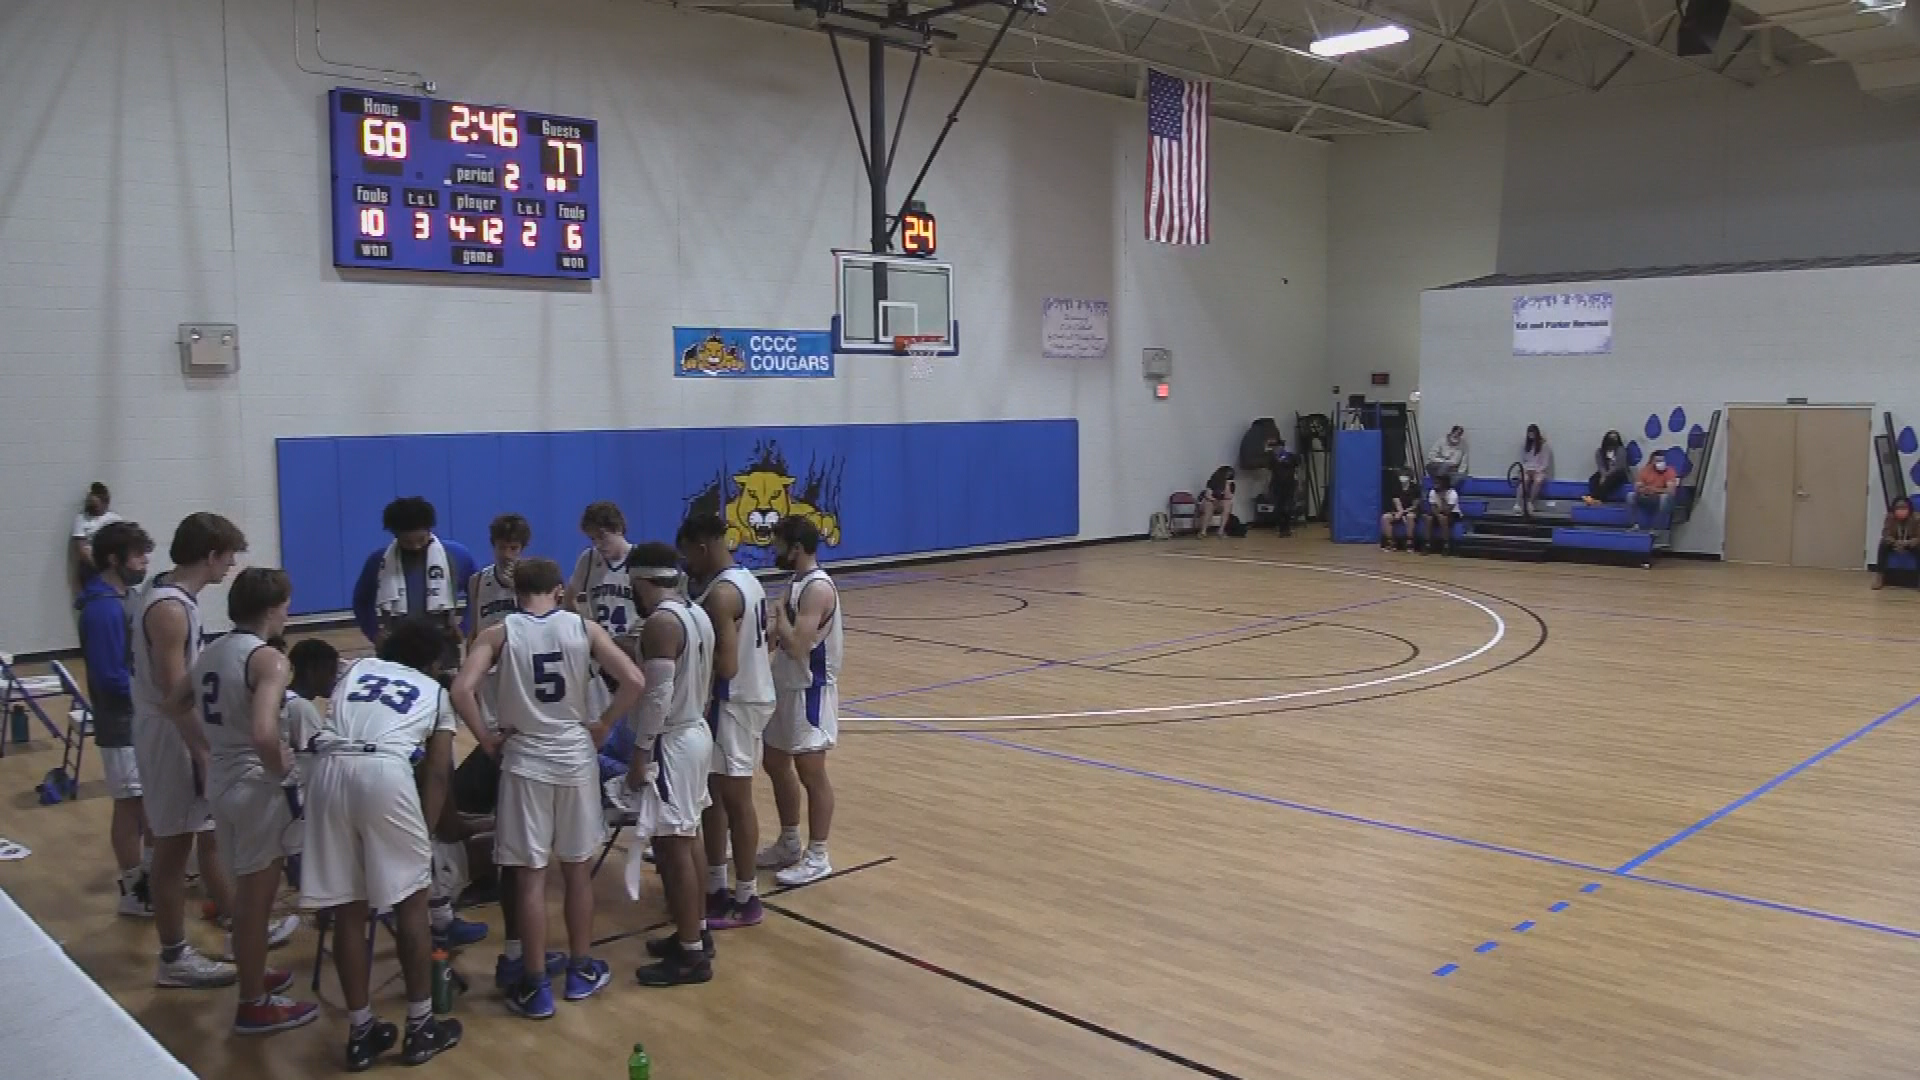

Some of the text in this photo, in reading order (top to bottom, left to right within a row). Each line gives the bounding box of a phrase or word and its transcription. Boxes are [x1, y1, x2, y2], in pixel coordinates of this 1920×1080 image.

[364, 98, 398, 116] Home
[362, 118, 407, 159] 68
[450, 105, 519, 148] 2:46
[542, 120, 581, 139] Guests
[547, 140, 582, 177] 77
[456, 167, 494, 186] period
[504, 164, 520, 191] 2
[457, 195, 497, 213] player
[360, 208, 385, 237] 10
[415, 212, 430, 239] 3
[522, 221, 537, 247] 2
[904, 215, 934, 249] 24
[361, 243, 388, 257] won
[566, 224, 582, 250] 6
[463, 249, 494, 265] game
[562, 257, 585, 269] won
[750, 336, 797, 352] CCCC
[750, 355, 830, 372] COUGARS
[597, 603, 627, 633] 24
[532, 651, 567, 703] 5
[202, 671, 224, 727] 2
[346, 673, 421, 715] 33
